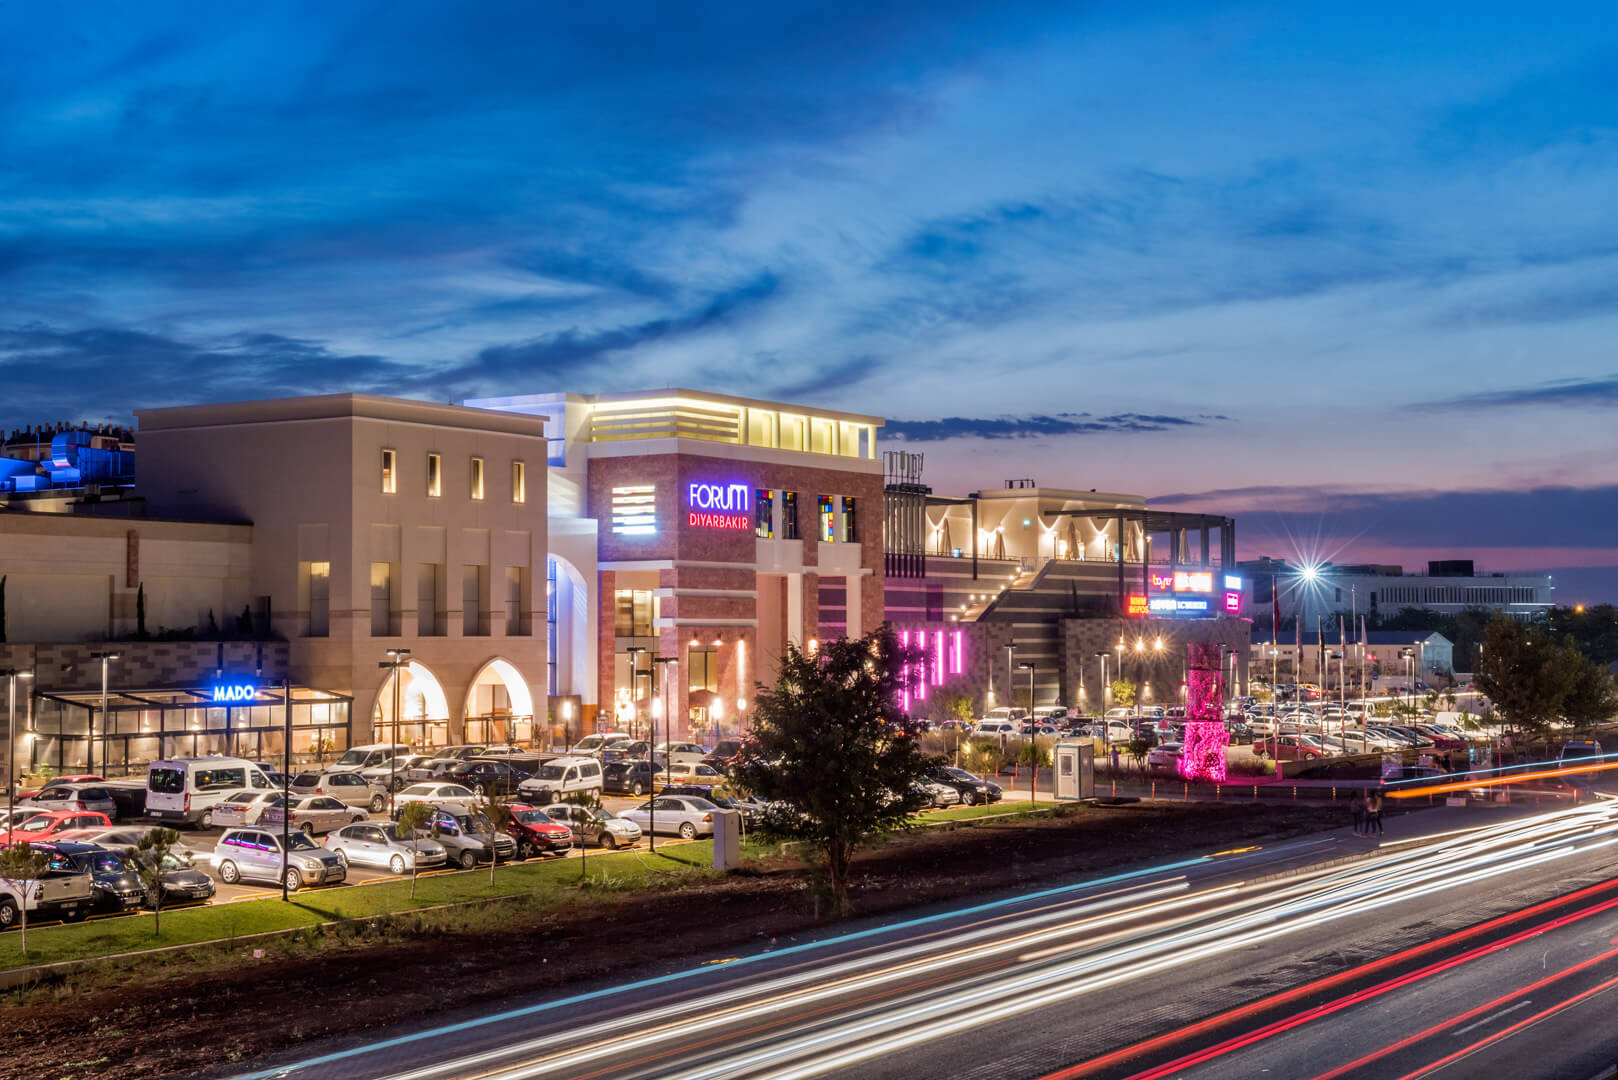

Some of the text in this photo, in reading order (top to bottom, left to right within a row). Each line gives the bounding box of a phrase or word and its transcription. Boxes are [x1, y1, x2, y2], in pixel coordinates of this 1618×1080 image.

[689, 483, 748, 511] FORUM
[689, 513, 749, 529] DIYARBAKIR
[213, 685, 255, 701] MADO
